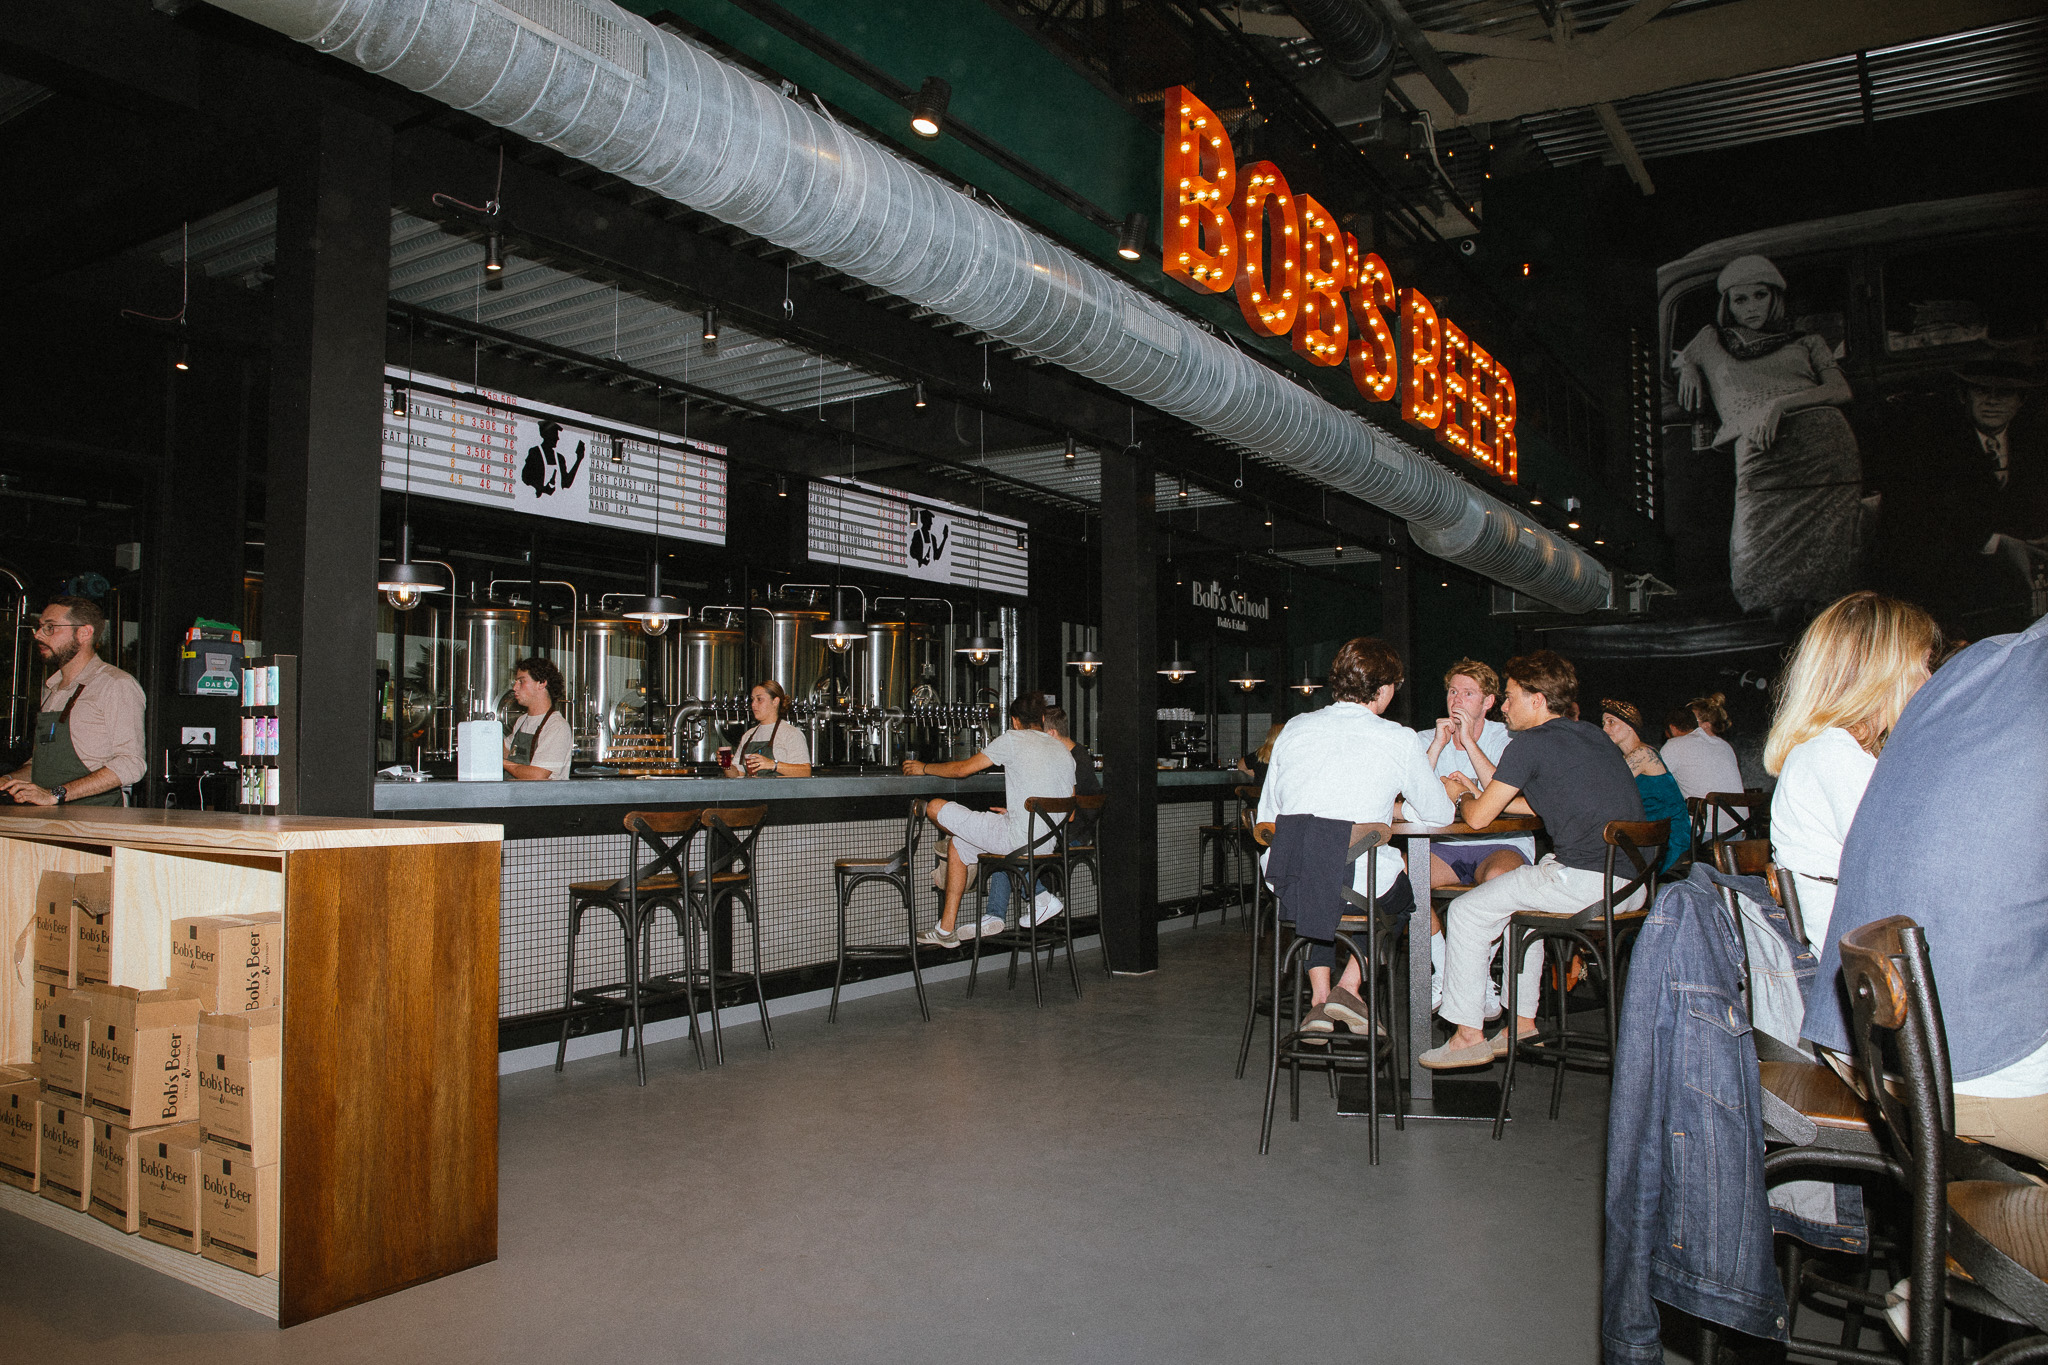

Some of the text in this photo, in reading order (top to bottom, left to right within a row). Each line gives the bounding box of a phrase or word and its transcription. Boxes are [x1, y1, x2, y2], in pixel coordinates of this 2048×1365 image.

[1163, 85, 1518, 485] BOB'S BEER
[383, 399, 515, 435] GOEN ALE 4,5 3,50€ 6€
[486, 406, 496, 417] 4€
[409, 435, 427, 447] ALE
[450, 443, 456, 453] 4
[466, 445, 491, 460] 3,50€
[503, 453, 514, 464] 6€
[451, 428, 515, 450] 2 4€ 7€
[592, 431, 612, 444] INDI
[480, 464, 491, 475] 4€
[503, 468, 514, 478] 7€
[590, 459, 610, 471] HAZY
[617, 463, 631, 475] IPA
[699, 481, 708, 491] 4€
[719, 484, 727, 494] 7€
[591, 445, 611, 458] COLD
[699, 467, 708, 477] 4€
[718, 471, 726, 482] 7€
[449, 473, 513, 493] 4,5 4€ 7€
[589, 472, 609, 484] WEST
[613, 476, 637, 489] COAST
[643, 481, 657, 493] IPA
[699, 493, 708, 503] 4€
[718, 497, 726, 507] 7€
[589, 486, 619, 500] DOUBLE
[625, 492, 639, 504] IPA
[698, 506, 708, 516] 4€
[718, 509, 726, 519] 7€
[589, 500, 609, 512] NANO
[615, 504, 629, 515] IPA
[698, 519, 708, 529] 4€
[718, 522, 726, 532] 7€
[809, 528, 840, 540] CATHARIN
[824, 541, 858, 556] HOUBONNEE
[1193, 580, 1269, 620] Bob's School
[37, 916, 68, 934] Bob's Beer
[80, 926, 100, 942] Bob's
[173, 940, 215, 962] Bob's Beer
[245, 931, 260, 1011] Bob's Beer
[43, 1029, 81, 1052] Bob's Beer
[91, 1040, 111, 1060] Bob's
[112, 1046, 131, 1066] Beer
[162, 1032, 182, 1119] Bob's Beer
[200, 1071, 245, 1097] Bob's Beer
[0, 1110, 33, 1132] ob's Beer
[43, 1123, 80, 1150] Bob's Beer
[108, 1145, 124, 1167] Beer
[140, 1157, 187, 1185] Bob's Beer
[203, 1174, 228, 1196] Bob's
[229, 1182, 252, 1204] Beer
